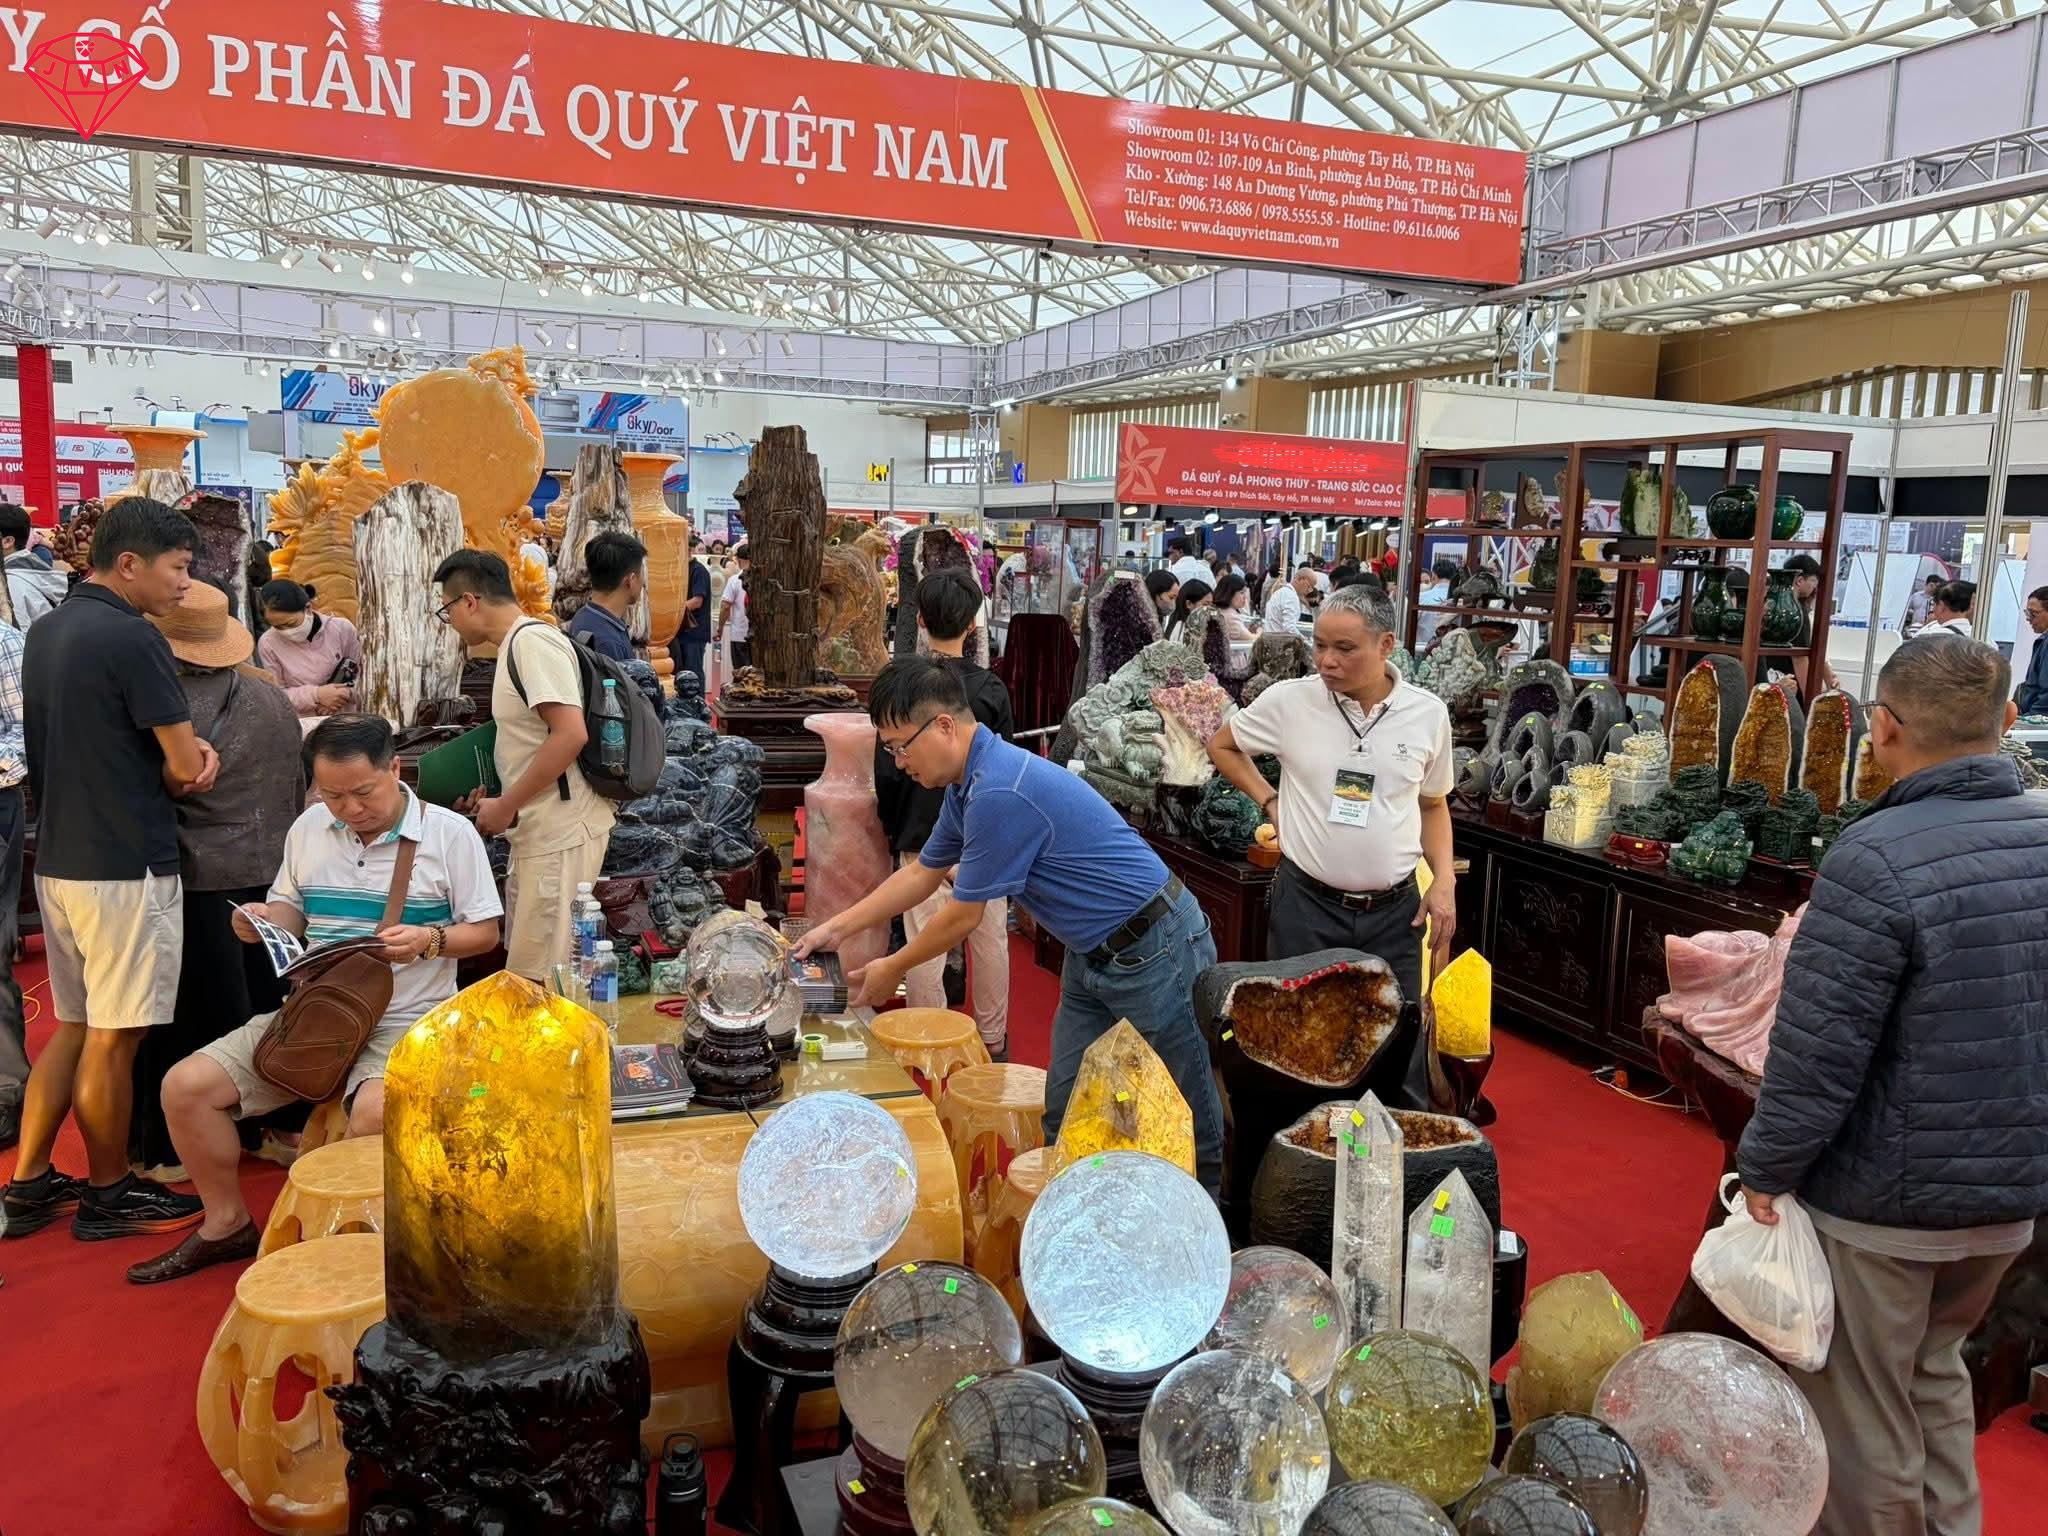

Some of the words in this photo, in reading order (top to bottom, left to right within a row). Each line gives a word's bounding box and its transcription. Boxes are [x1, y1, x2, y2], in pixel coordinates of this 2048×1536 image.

[207, 11, 415, 119] PHẦN
[442, 54, 546, 137] ĐÁ
[566, 77, 698, 160] QUÝ
[717, 95, 856, 185] VIỆT
[873, 124, 1008, 191] NAM
[1126, 140, 1193, 164] Showroom
[1196, 149, 1214, 167] 02:
[1218, 152, 1262, 172] 107-109
[1265, 158, 1282, 175] An
[1286, 160, 1317, 181] Bình,
[1319, 165, 1362, 188] phường
[1364, 171, 1381, 188] An
[1384, 173, 1418, 195] Đông,
[1421, 178, 1438, 194] TP.
[1441, 178, 1458, 197] Hồ
[1460, 182, 1480, 200] Chí
[1482, 185, 1512, 203] Minh
[1127, 118, 1194, 141] Showroom
[1197, 127, 1215, 145] 01:
[1219, 130, 1240, 148] 134
[1242, 132, 1259, 150] Võ
[1262, 135, 1284, 153] Chí
[1286, 139, 1320, 161] Công,
[1322, 144, 1366, 168] phường
[1368, 150, 1390, 170] Tây
[1392, 152, 1412, 173] Hồ,
[1416, 156, 1433, 173] TP.
[1435, 158, 1452, 175] Hà
[1454, 161, 1475, 182] Nội
[1125, 163, 1152, 181] Kho
[1164, 167, 1209, 191] Xưởng:
[1212, 174, 1232, 191] 148
[1235, 176, 1252, 193] An
[1256, 179, 1296, 201] Dương
[1299, 184, 1338, 206] Vương,
[1341, 190, 1384, 212] phường
[1386, 195, 1408, 212] Phú
[1411, 198, 1457, 220] Thượng,
[1460, 204, 1477, 220] TP.
[1480, 205, 1495, 223] Hà
[1498, 208, 1518, 228] Nội
[1125, 187, 1175, 208] Tel/Fax:
[1178, 194, 1252, 217] 0906.73.6886
[1262, 204, 1334, 226] 0978.5555.58
[1343, 213, 1390, 232] Hotline:
[1393, 218, 1460, 241] 09.6116.0066
[1124, 210, 1177, 230] Website:
[1181, 219, 1339, 248] www.daquyvietnam.com.vn
[1182, 469, 1197, 482] ĐÁ
[1200, 470, 1221, 484] QUÝ
[1229, 472, 1245, 485] ĐÁ
[1247, 475, 1283, 488] PHONG
[1317, 479, 1348, 491] TRANG
[1351, 479, 1370, 492] SỨC
[1372, 483, 1394, 494] CAO
